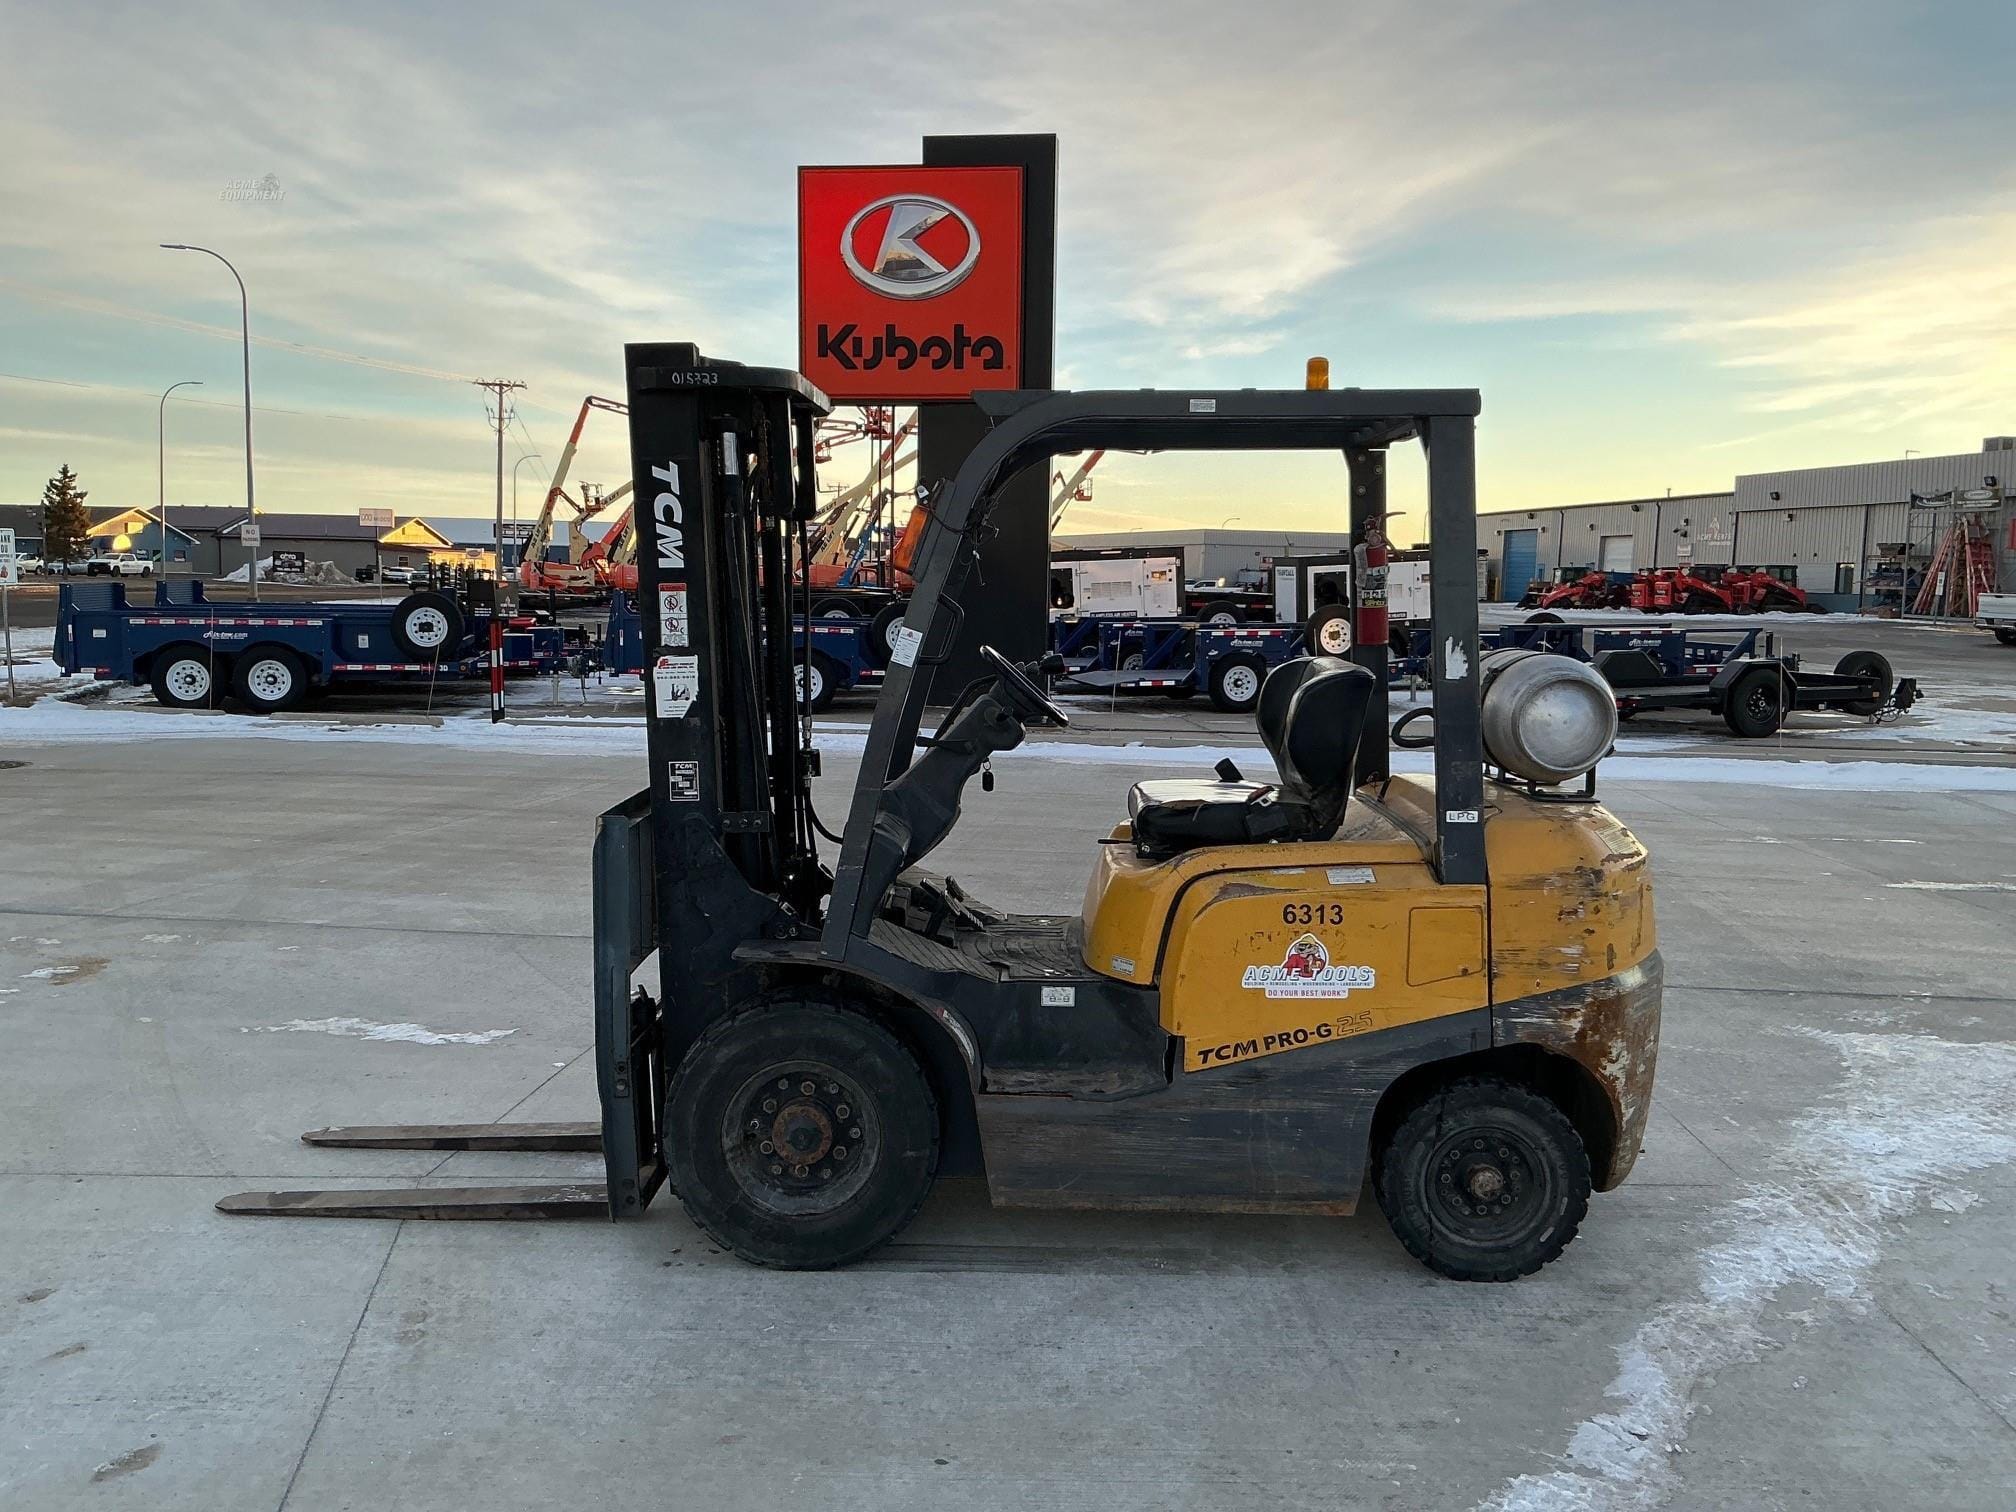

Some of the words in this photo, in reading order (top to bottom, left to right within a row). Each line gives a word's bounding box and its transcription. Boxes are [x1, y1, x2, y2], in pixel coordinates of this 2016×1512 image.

[817, 324, 1004, 371] Kubota
[652, 461, 685, 568] TCM
[1449, 812, 1475, 821] LPG
[1283, 903, 1344, 925] 6313
[1245, 967, 1301, 981] ACME
[1310, 967, 1371, 981] TOOLS
[1268, 989, 1278, 997] DO
[1279, 989, 1299, 997] YOUR
[1301, 989, 1319, 997] BEST
[1197, 1039, 1259, 1065] TCM
[1263, 1023, 1332, 1051] PRO-G
